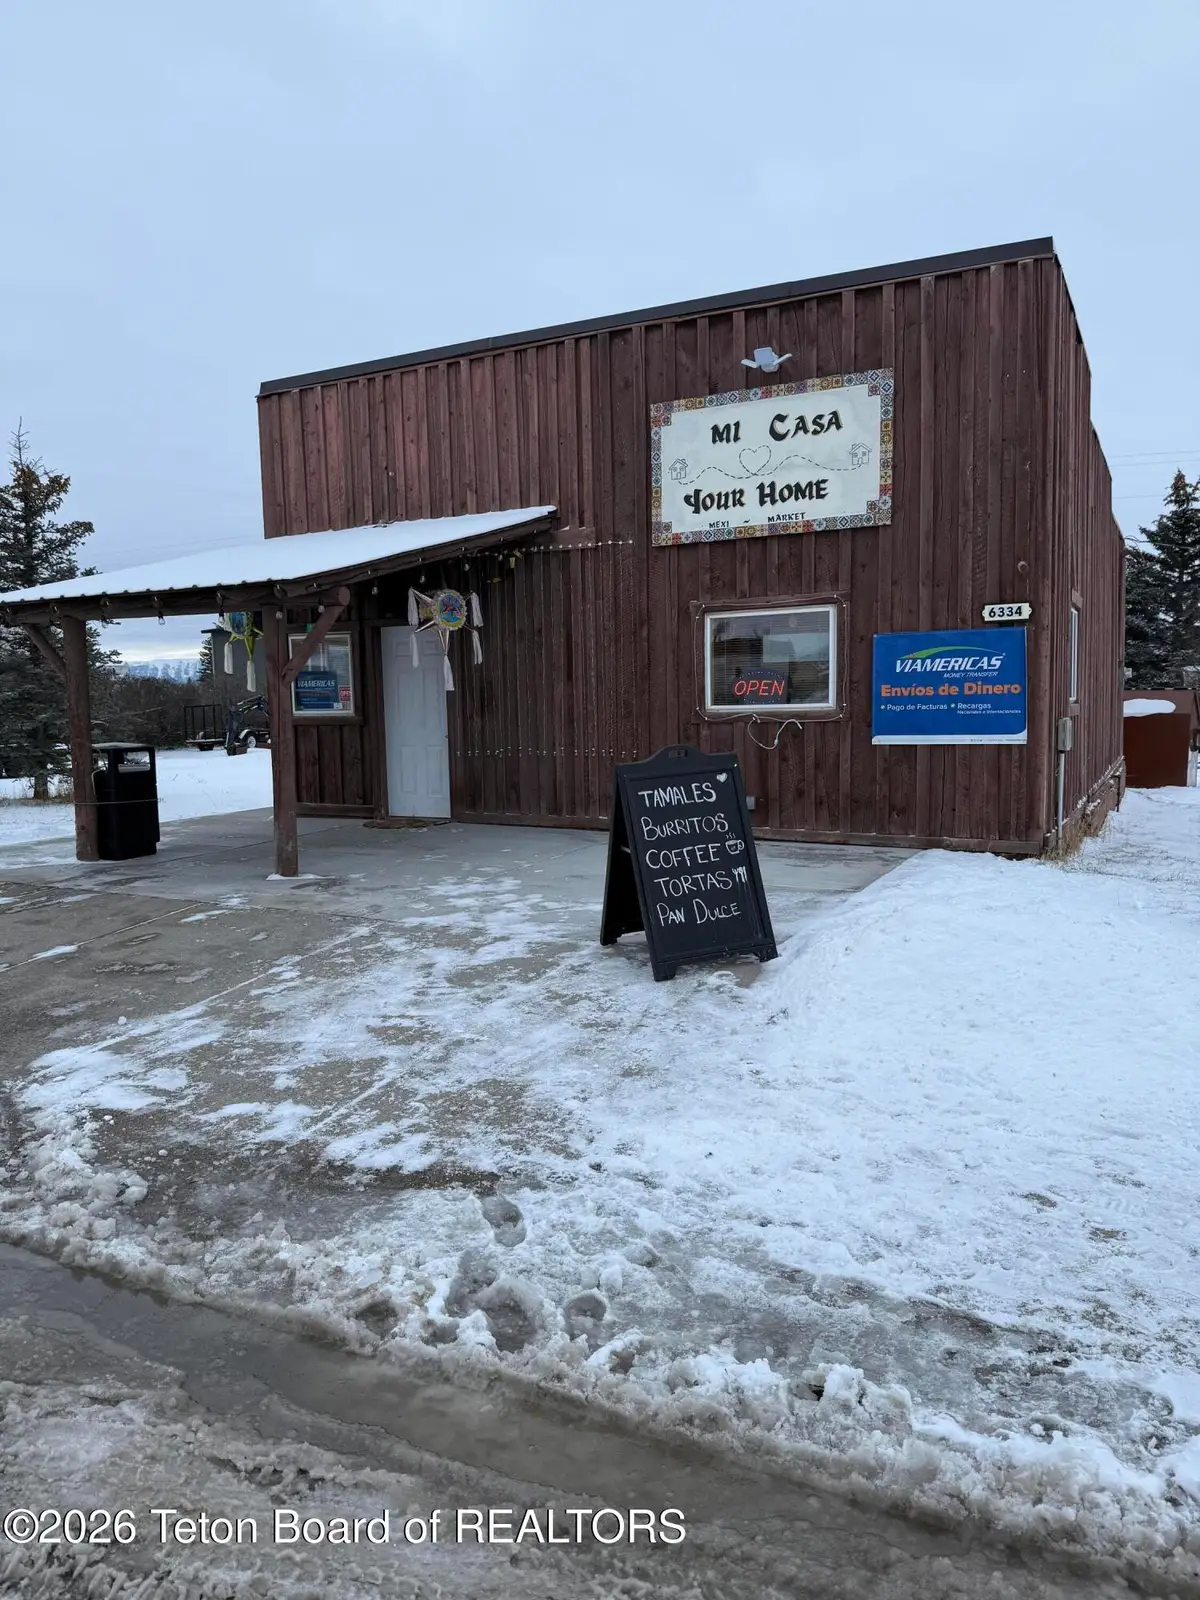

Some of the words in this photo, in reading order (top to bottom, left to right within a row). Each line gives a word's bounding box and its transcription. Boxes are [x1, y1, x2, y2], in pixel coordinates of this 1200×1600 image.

[710, 421, 741, 445] MI
[756, 478, 829, 507] HOME
[708, 520, 730, 529] MEXI
[767, 511, 807, 523] MARKET
[988, 605, 1023, 618] 6334
[895, 657, 1002, 673] VIAMERICAS
[734, 680, 785, 697] OPEN
[881, 684, 935, 697] Envíos
[938, 683, 960, 696] de
[963, 681, 1022, 695] Dinero
[886, 704, 905, 712] Pago
[917, 703, 948, 711] Facturas
[957, 702, 992, 710] Recargas
[638, 782, 717, 808] TAMALES
[645, 843, 721, 869] COFFEE
[654, 870, 733, 898] TORTAS
